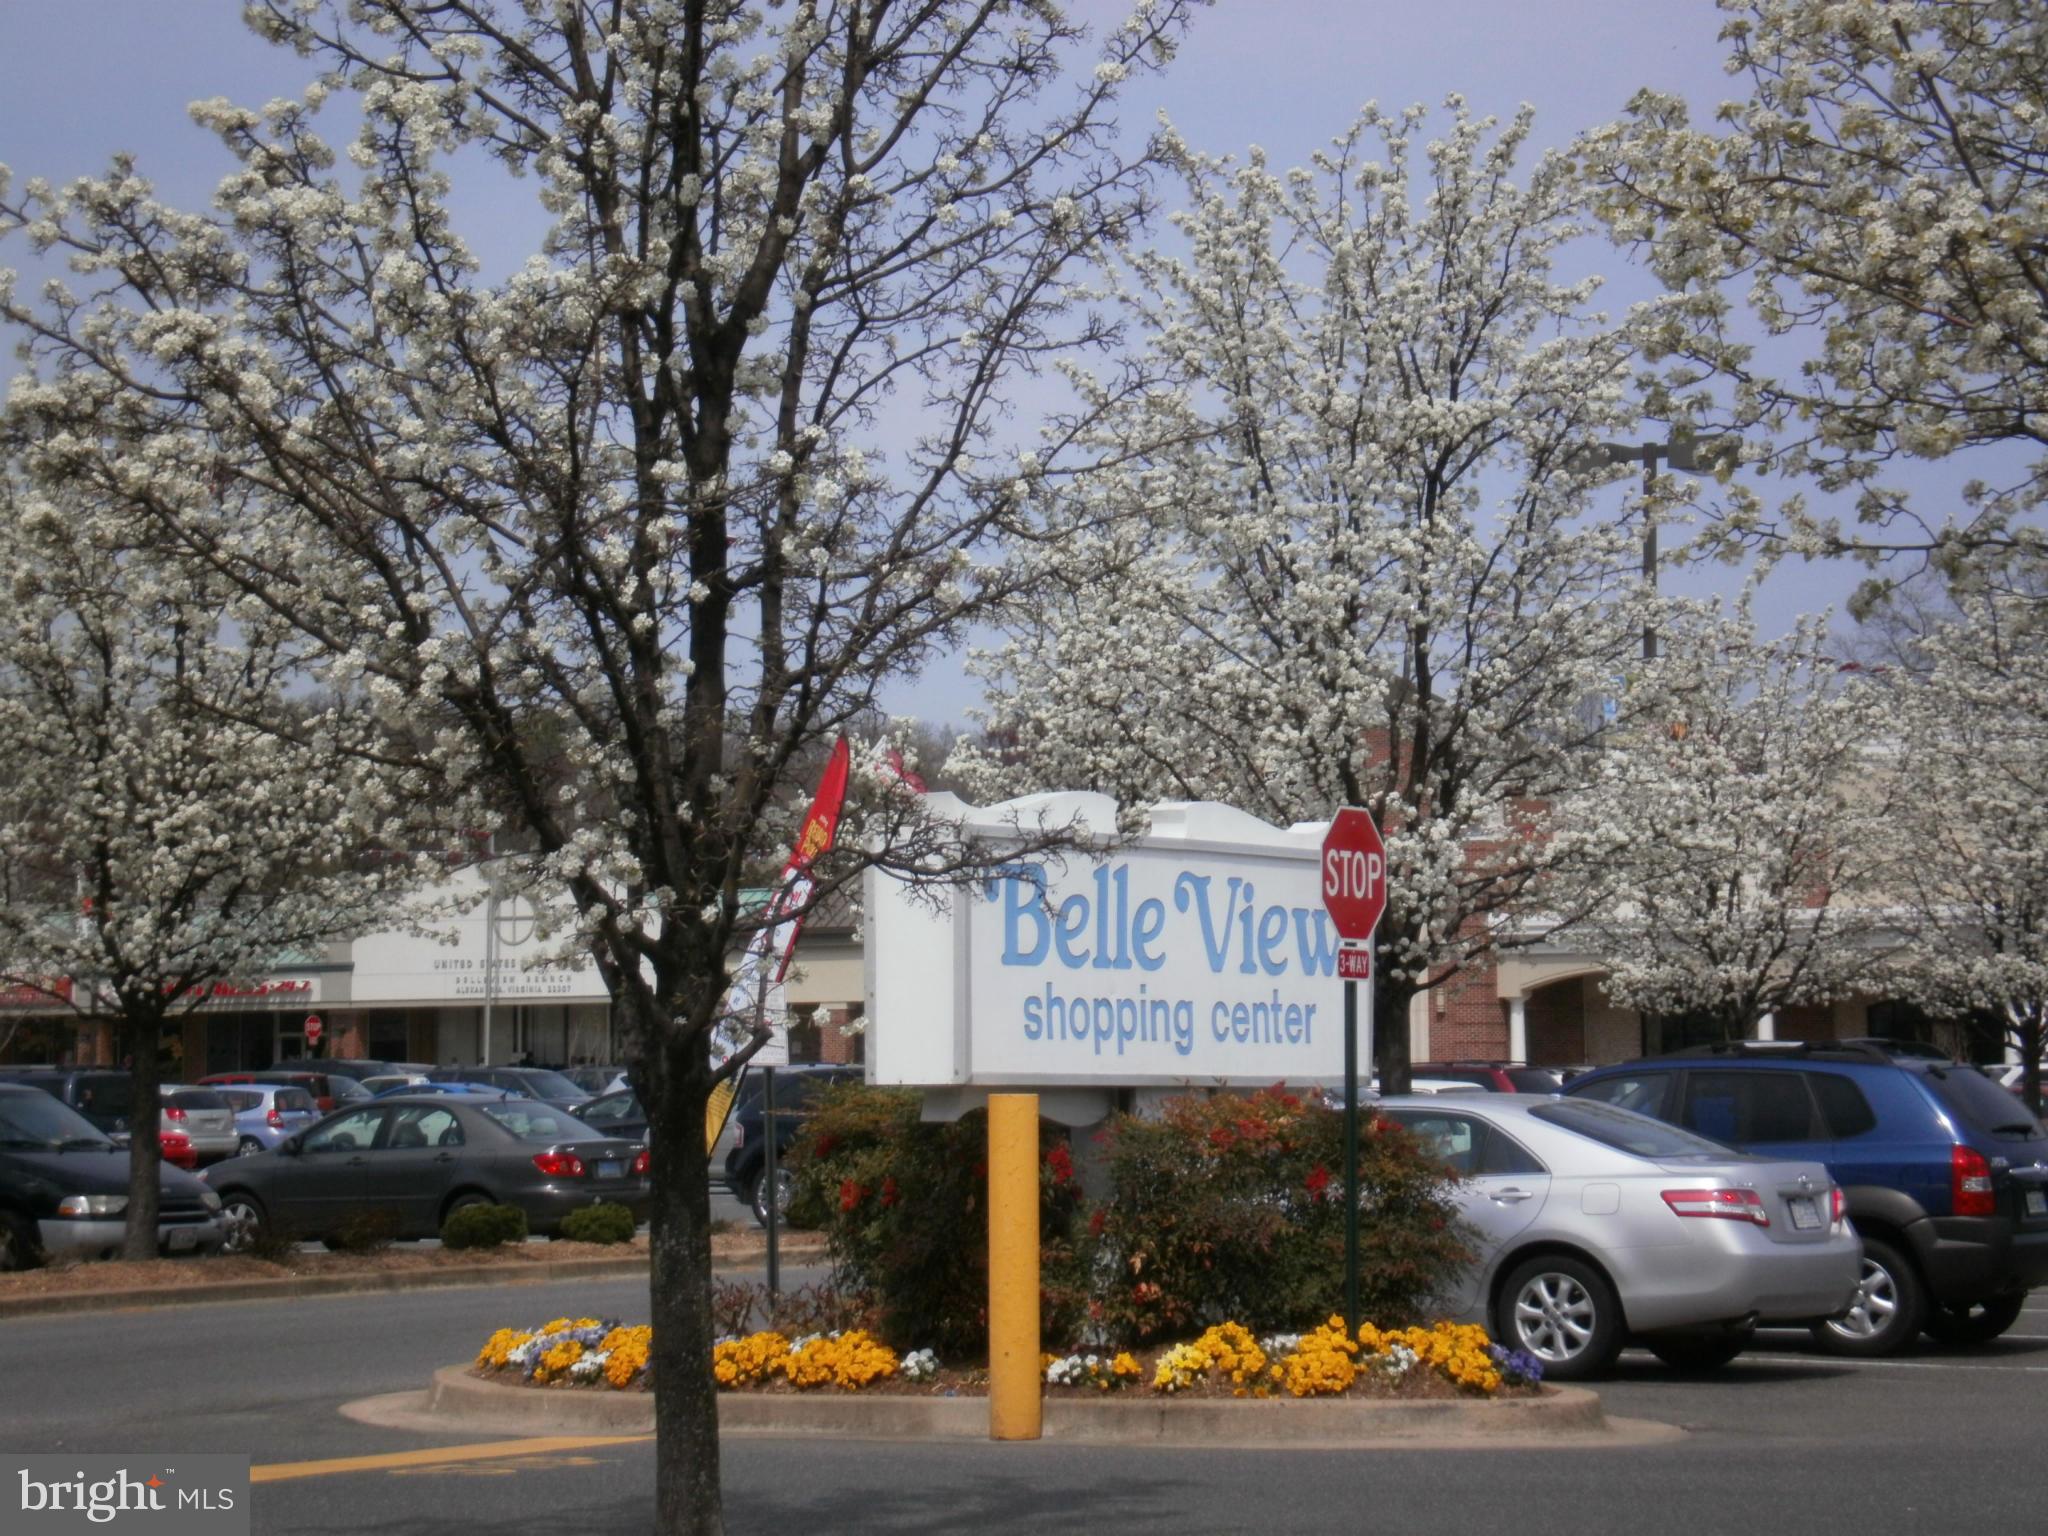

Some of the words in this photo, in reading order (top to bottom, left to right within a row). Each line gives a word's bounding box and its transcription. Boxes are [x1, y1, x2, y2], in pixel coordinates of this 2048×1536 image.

[1325, 848, 1382, 899] STOP
[984, 863, 1167, 972] Belle
[1174, 870, 1339, 977] View
[433, 959, 473, 970] UNITED
[479, 958, 517, 969] SATES
[1339, 955, 1369, 975] 3-WAY
[1023, 981, 1194, 1056] shopping
[1211, 988, 1317, 1045] center
